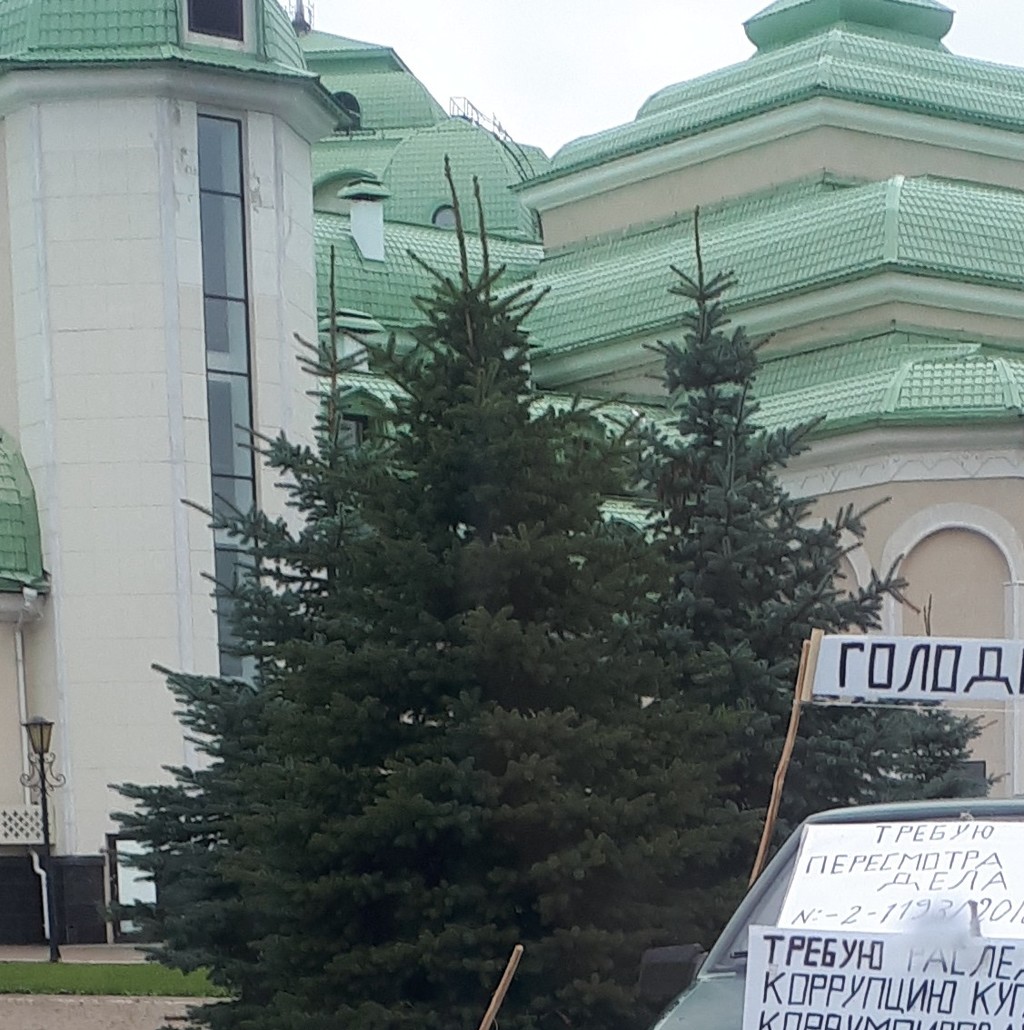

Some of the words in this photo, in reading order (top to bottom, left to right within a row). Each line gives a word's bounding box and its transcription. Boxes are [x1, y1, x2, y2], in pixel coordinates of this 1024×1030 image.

[876, 824, 995, 844] ТРЕБУЮ
[805, 850, 1003, 875] ПЕРЕСМОТРА
[876, 870, 1008, 892] ДЕЛА
[763, 935, 884, 970] ТРЕБУЮ
[762, 971, 957, 1014] КОРРУПЦИЮ
